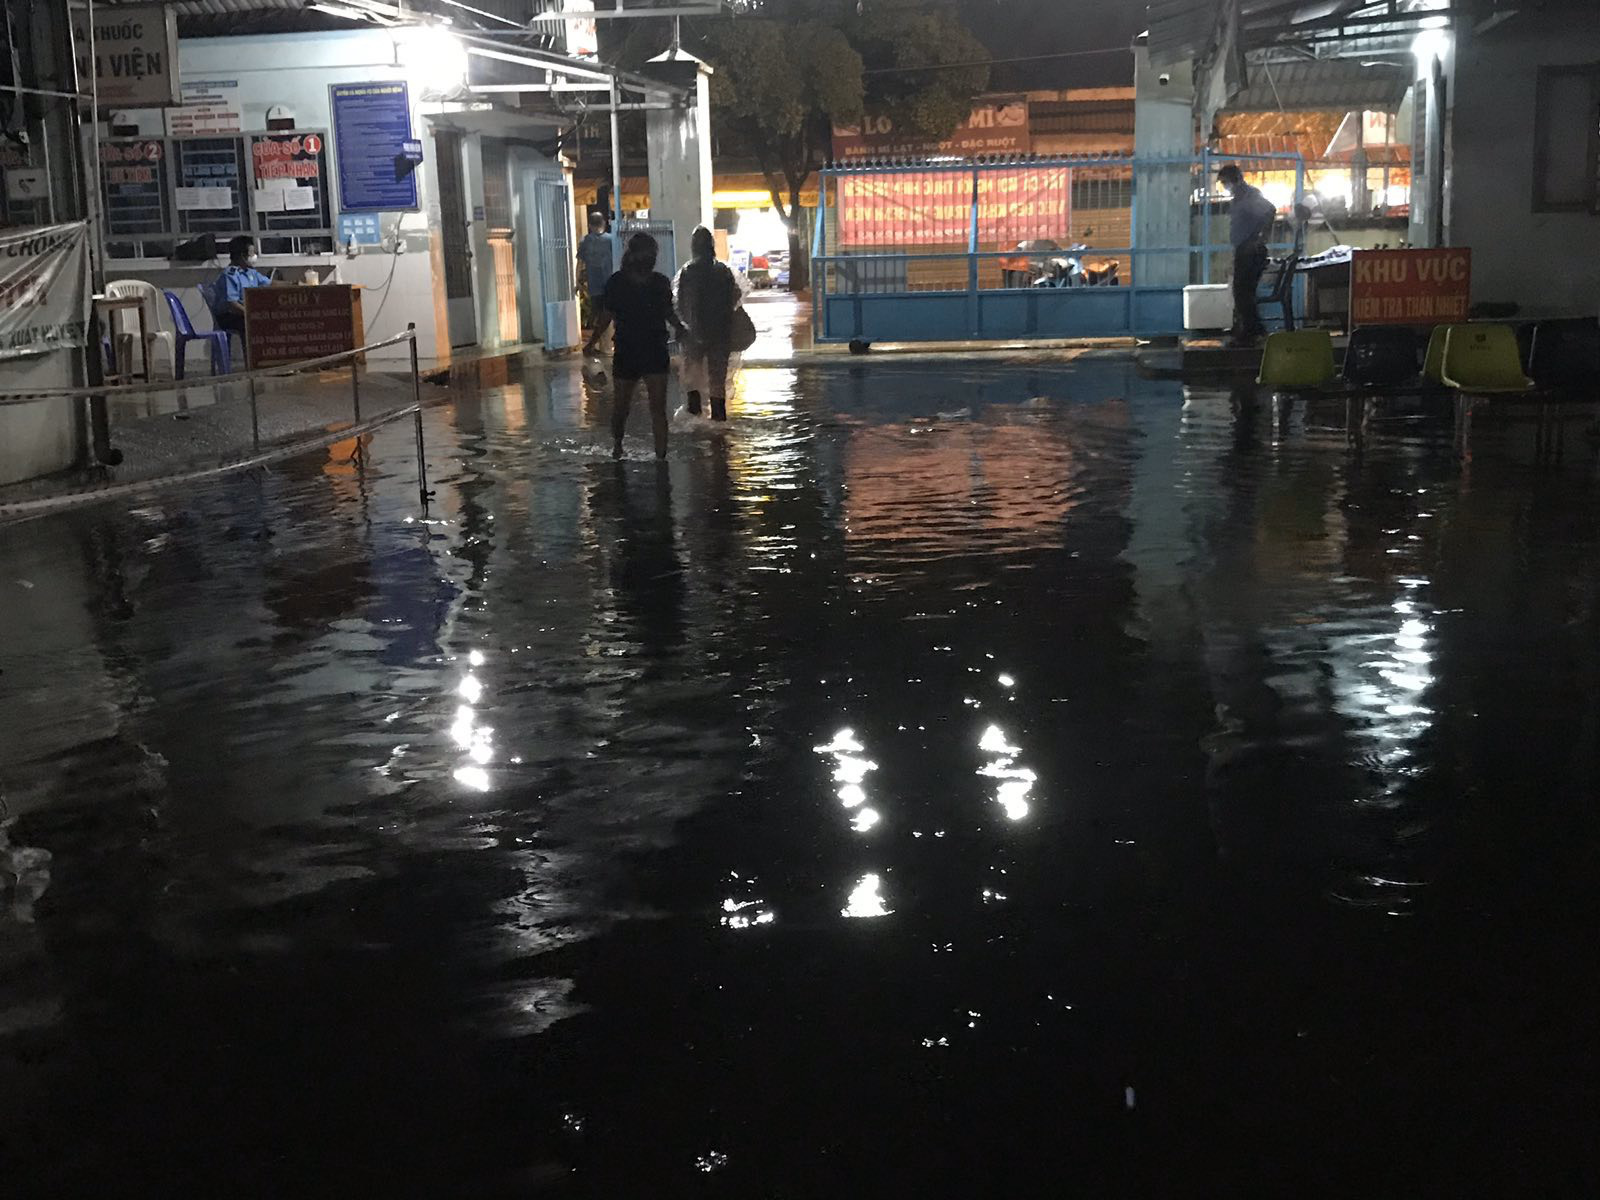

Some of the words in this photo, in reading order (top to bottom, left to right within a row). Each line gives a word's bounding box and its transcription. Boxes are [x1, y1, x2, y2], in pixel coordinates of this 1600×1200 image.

[109, 46, 162, 80] VIỆN
[1355, 258, 1408, 284] KHU
[1415, 254, 1467, 287] VỰC
[1383, 296, 1403, 318] TRA
